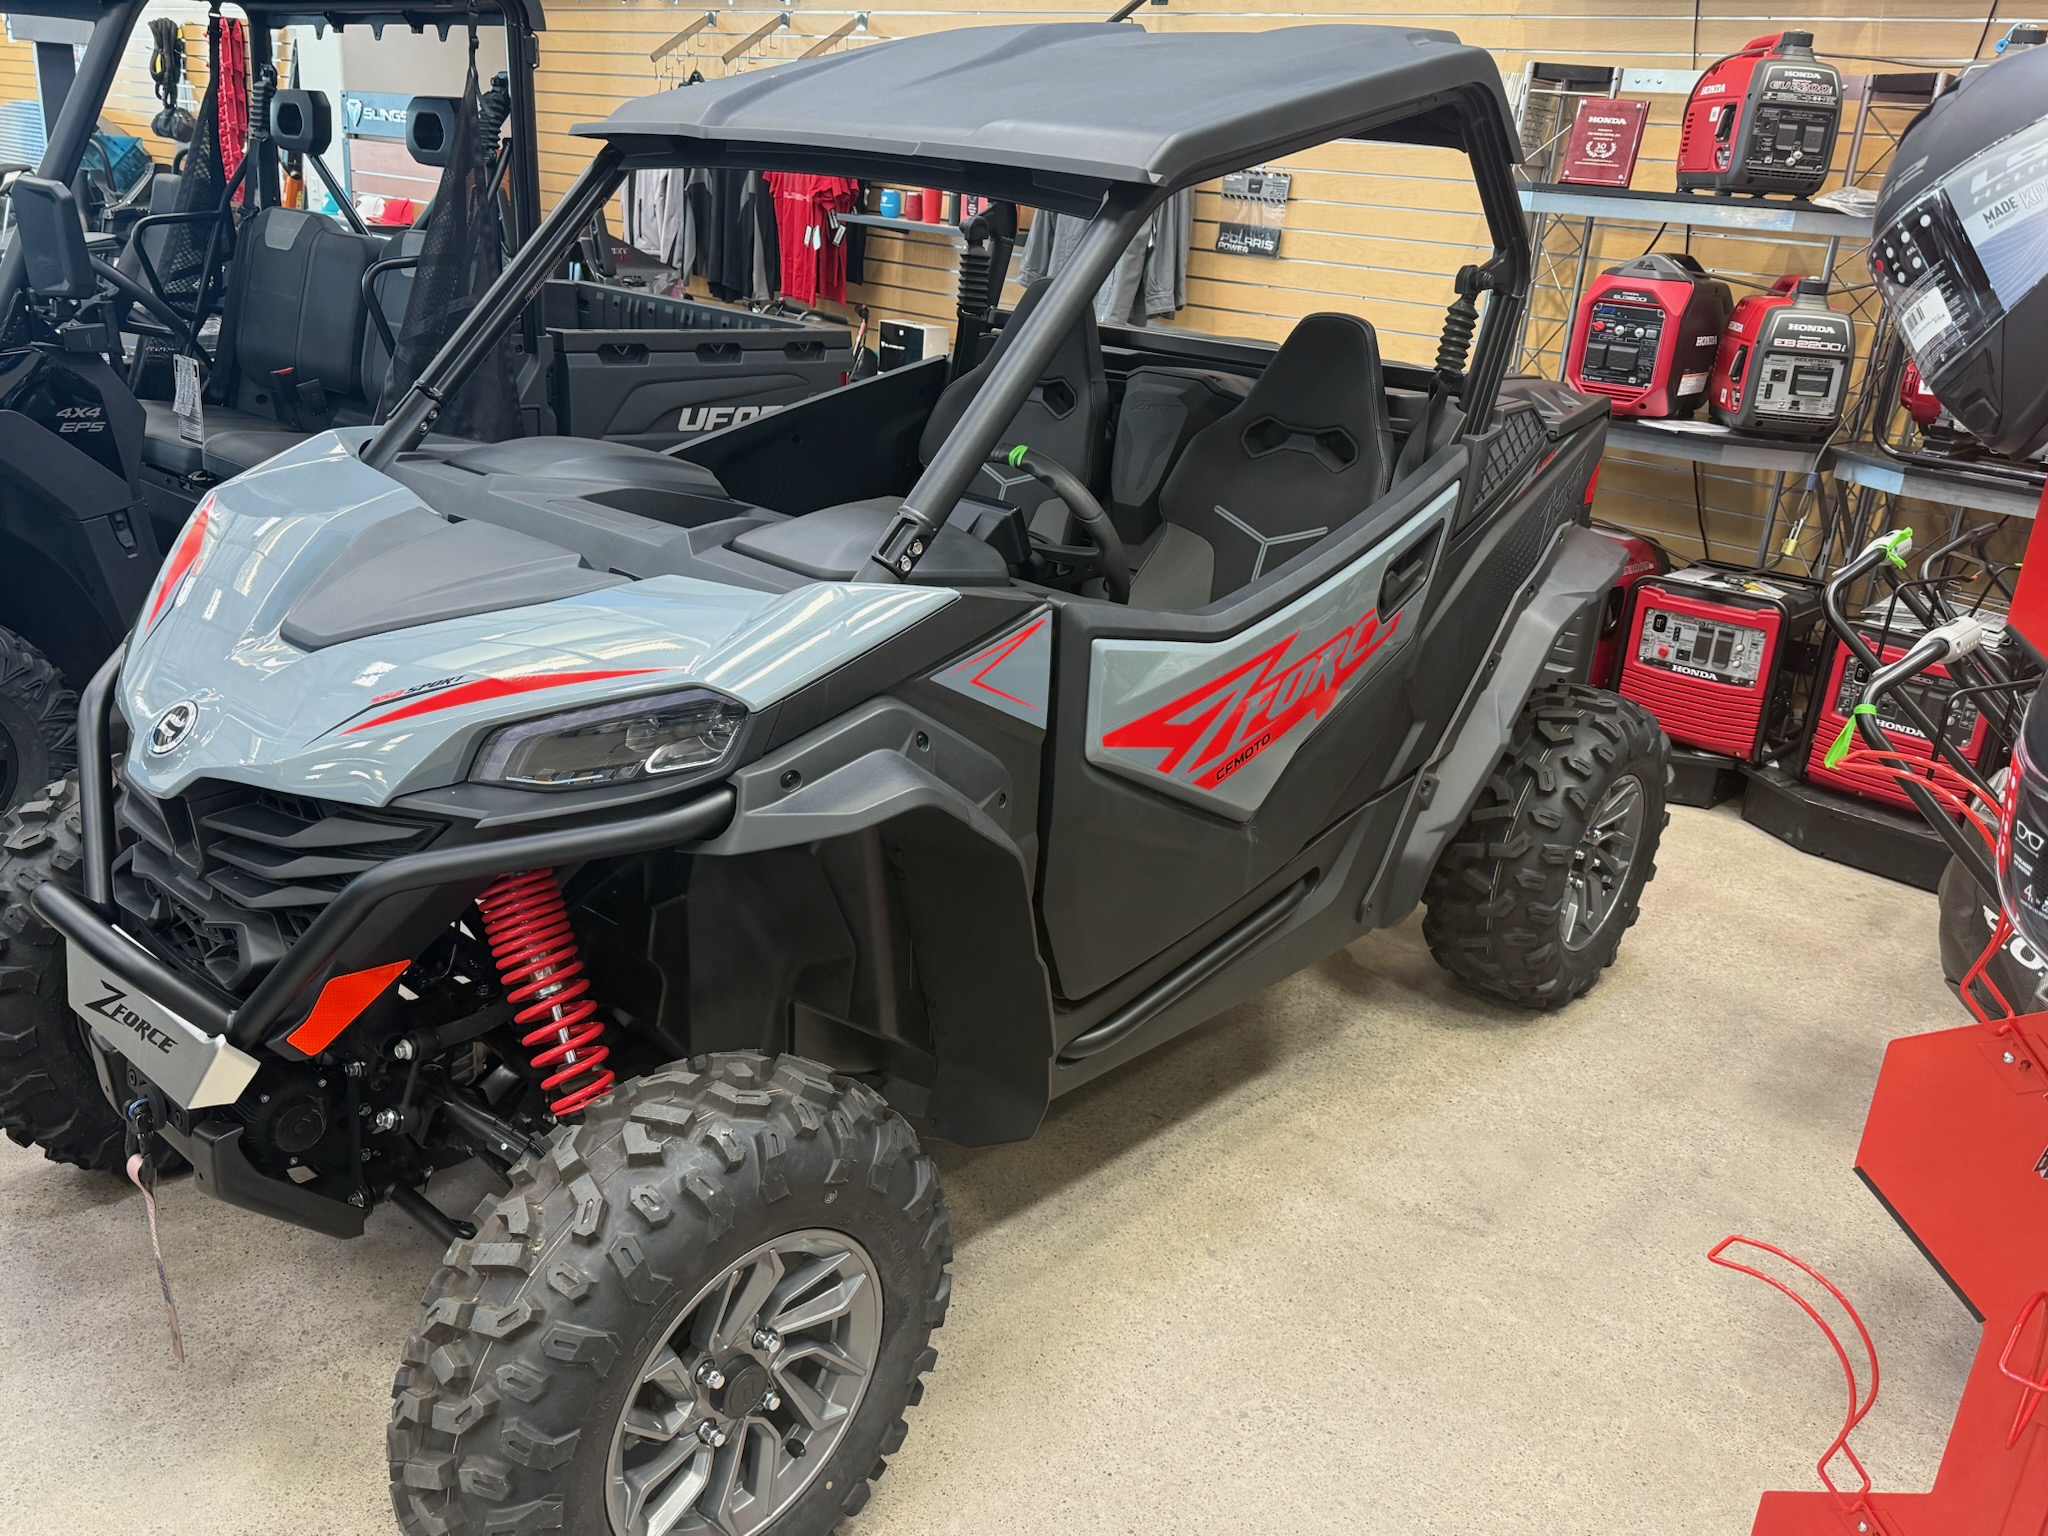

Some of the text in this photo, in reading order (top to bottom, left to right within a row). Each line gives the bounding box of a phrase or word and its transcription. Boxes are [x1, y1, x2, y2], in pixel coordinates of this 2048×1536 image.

[1784, 70, 1822, 80] HONDA
[1699, 83, 1727, 96] HONDA
[1587, 115, 1628, 126] HONDA
[1982, 195, 2019, 225] MADE
[1217, 241, 1249, 254] POWER
[1219, 231, 1275, 252] POLARIS
[1787, 322, 1836, 335] HONDA
[1695, 335, 1718, 347] HONDA
[1772, 337, 1847, 353] EB2200i
[56, 406, 102, 419] 4X4
[59, 421, 107, 434] EPS
[1670, 663, 1719, 681] HONDA
[405, 674, 470, 695] SPORT
[1875, 717, 1927, 738] HONDA
[1215, 732, 1272, 782] CFMOTO
[84, 978, 179, 1055] ZFORCE
